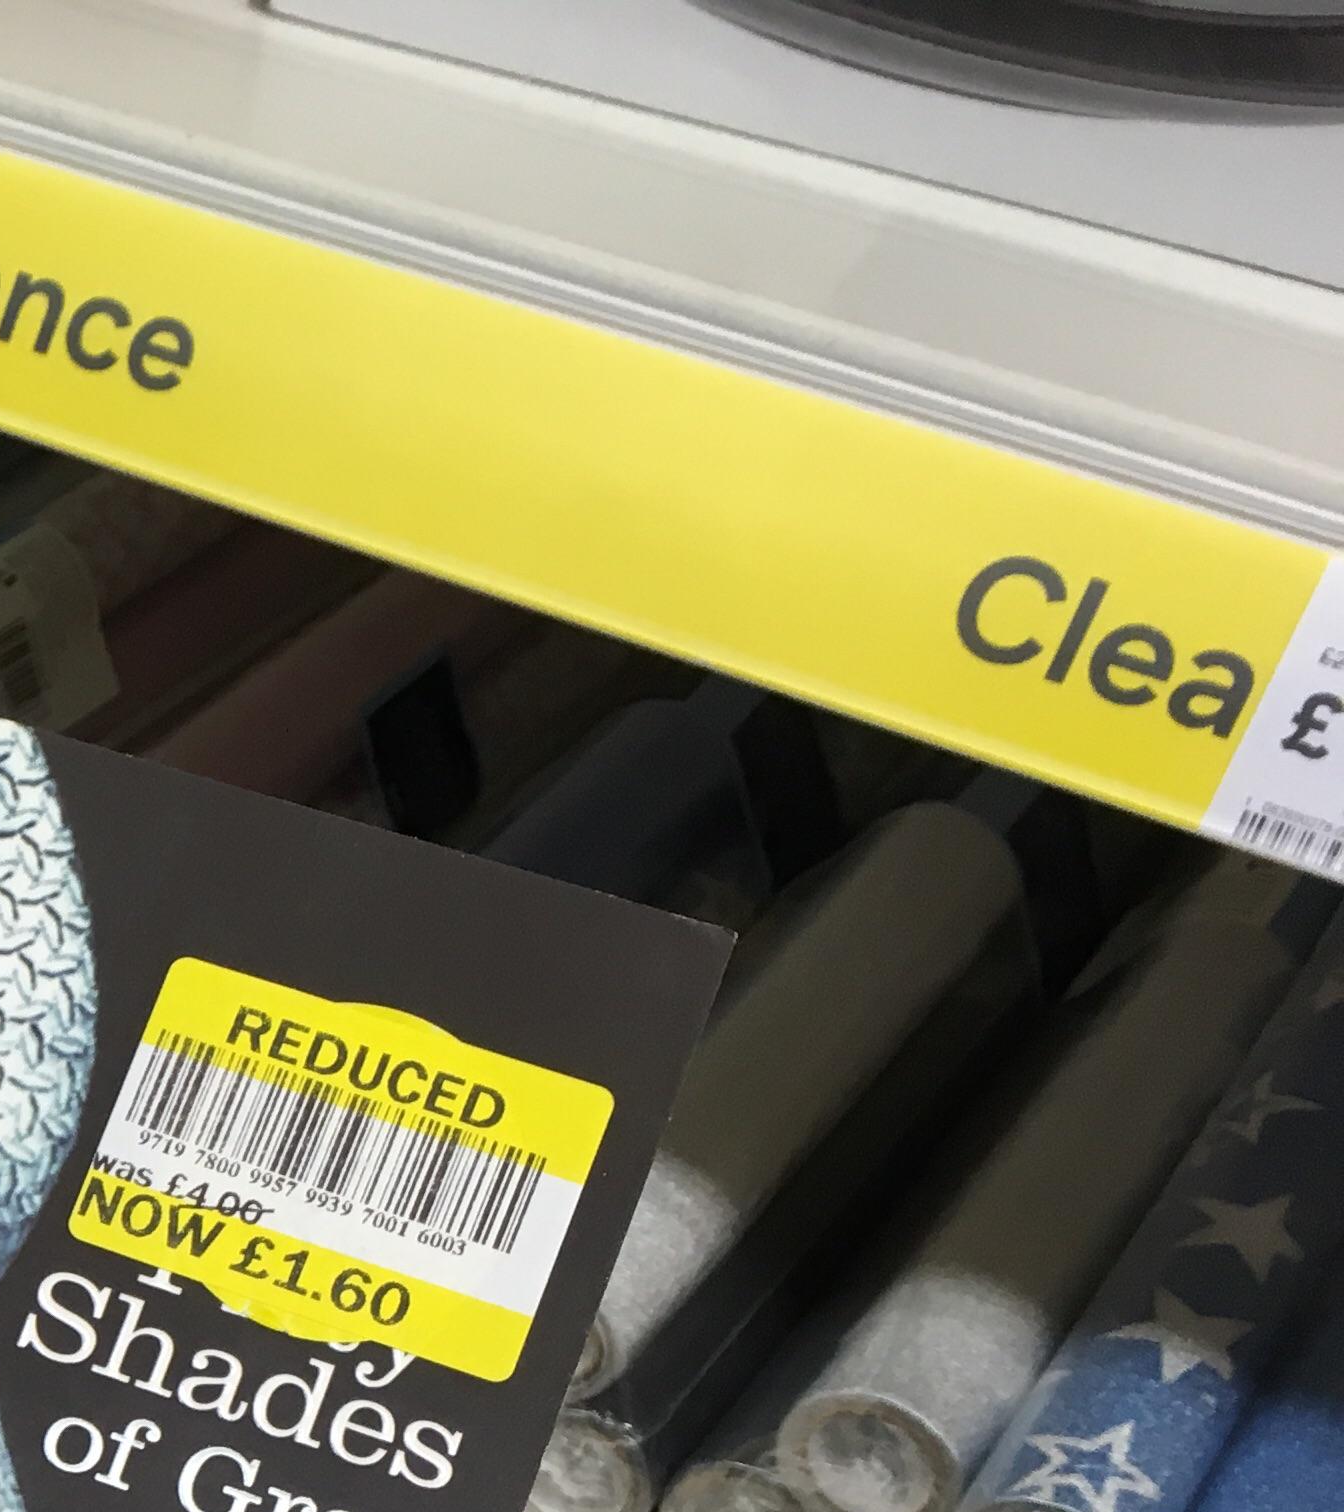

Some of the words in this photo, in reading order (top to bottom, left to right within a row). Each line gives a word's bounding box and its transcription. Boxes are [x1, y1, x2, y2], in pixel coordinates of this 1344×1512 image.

[956, 555, 1255, 740] Clea
[225, 1005, 506, 1129] REDUCED
[92, 1152, 153, 1188] was
[137, 1131, 186, 1157] 9719
[193, 1151, 242, 1178] 7800
[249, 1169, 297, 1197] 9957
[361, 1208, 410, 1237] 7001
[417, 1228, 467, 1257] 6003
[77, 1177, 226, 1259] NOW
[229, 1235, 411, 1327] £1.60
[16, 1271, 463, 1490] Shades
[42, 1415, 162, 1492] of
